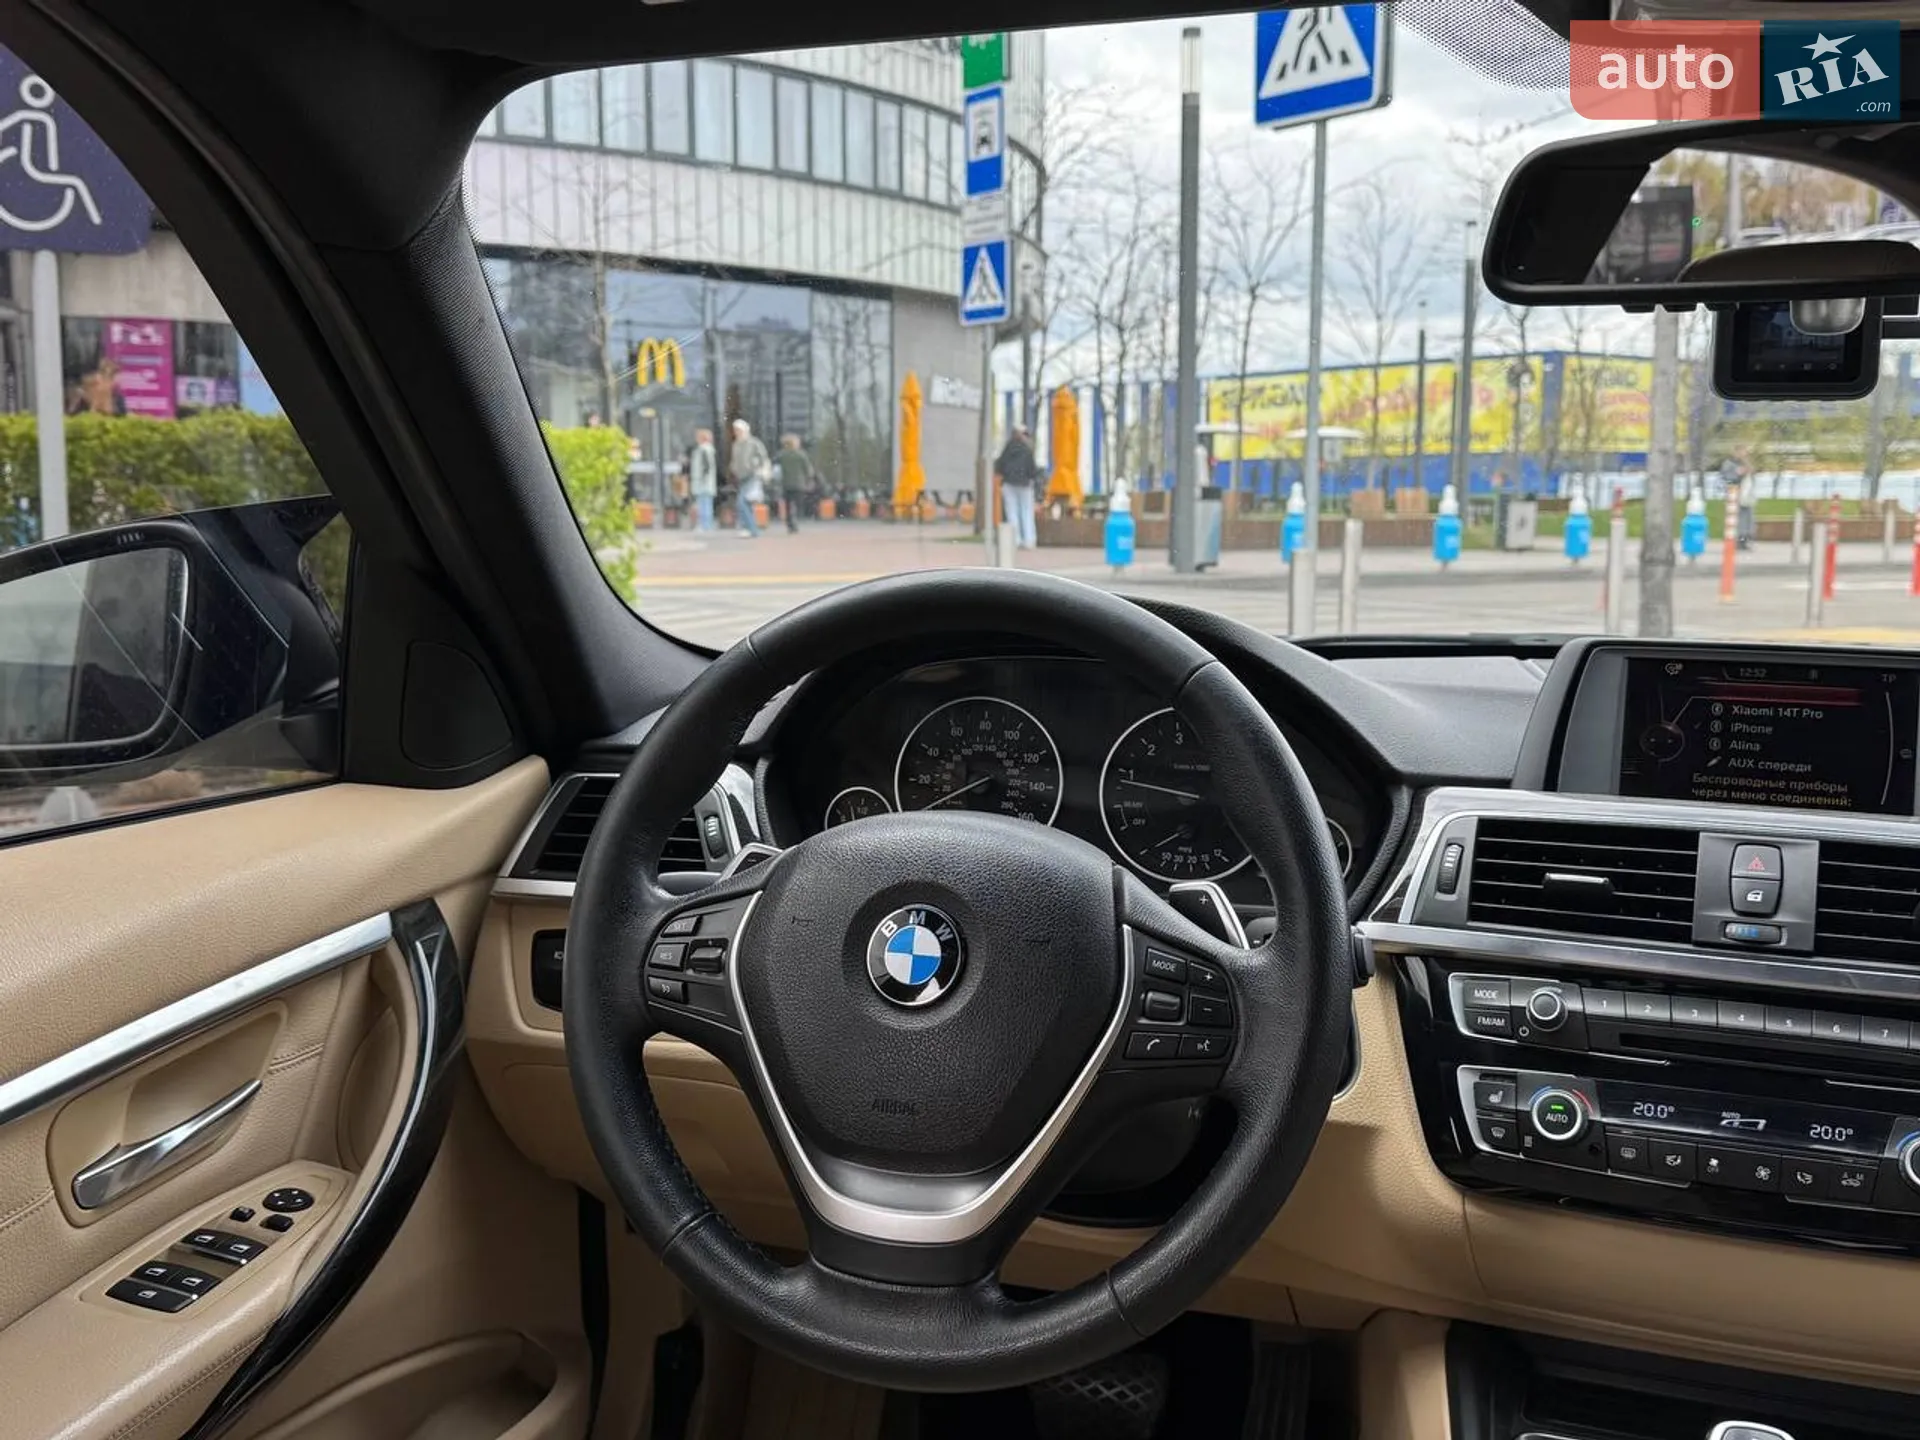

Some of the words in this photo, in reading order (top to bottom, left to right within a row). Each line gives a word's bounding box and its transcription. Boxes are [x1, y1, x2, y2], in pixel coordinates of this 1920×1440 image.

[1739, 667, 1768, 679] 12:52
[1731, 704, 1774, 717] Xiaomi
[1778, 707, 1799, 718] 14T
[1802, 708, 1824, 720] Pro
[979, 720, 992, 731] 80
[951, 726, 963, 737] 60
[1003, 730, 1020, 741] 100
[1175, 733, 1184, 745] 3
[1147, 744, 1156, 756] 2
[1729, 739, 1762, 752] Alina
[927, 747, 939, 757] 40
[1023, 753, 1040, 764] 120
[1727, 757, 1755, 769] AUX
[1757, 760, 1813, 773] спереди
[918, 774, 931, 784] 20
[1128, 769, 1134, 781] 1
[1028, 781, 1046, 792] 140
[1692, 772, 1787, 790] Беспроводные
[1789, 780, 1849, 794] приборы
[1691, 787, 1728, 800] через
[1731, 790, 1767, 802] меню
[1161, 852, 1172, 861] 50
[1201, 854, 1210, 863] 15
[1213, 849, 1223, 857] 12
[1173, 855, 1184, 863] 30
[1187, 856, 1198, 864] 20
[881, 910, 953, 941] BMW
[1152, 960, 1177, 972] MODE
[1474, 988, 1498, 1000] MODE
[1602, 1000, 1608, 1009] 1
[1644, 1004, 1652, 1013] 2
[1691, 1009, 1698, 1018] 3
[1737, 1013, 1745, 1022] 4
[1477, 1016, 1505, 1027] FM/AM
[1786, 1018, 1793, 1028] 5
[1832, 1024, 1841, 1033] 6
[1881, 1028, 1889, 1038] 7
[1632, 1101, 1676, 1119] 20.0°
[1721, 1111, 1741, 1120] AUTO
[1545, 1112, 1569, 1124] AUTO
[1809, 1123, 1854, 1142] 20.0°
